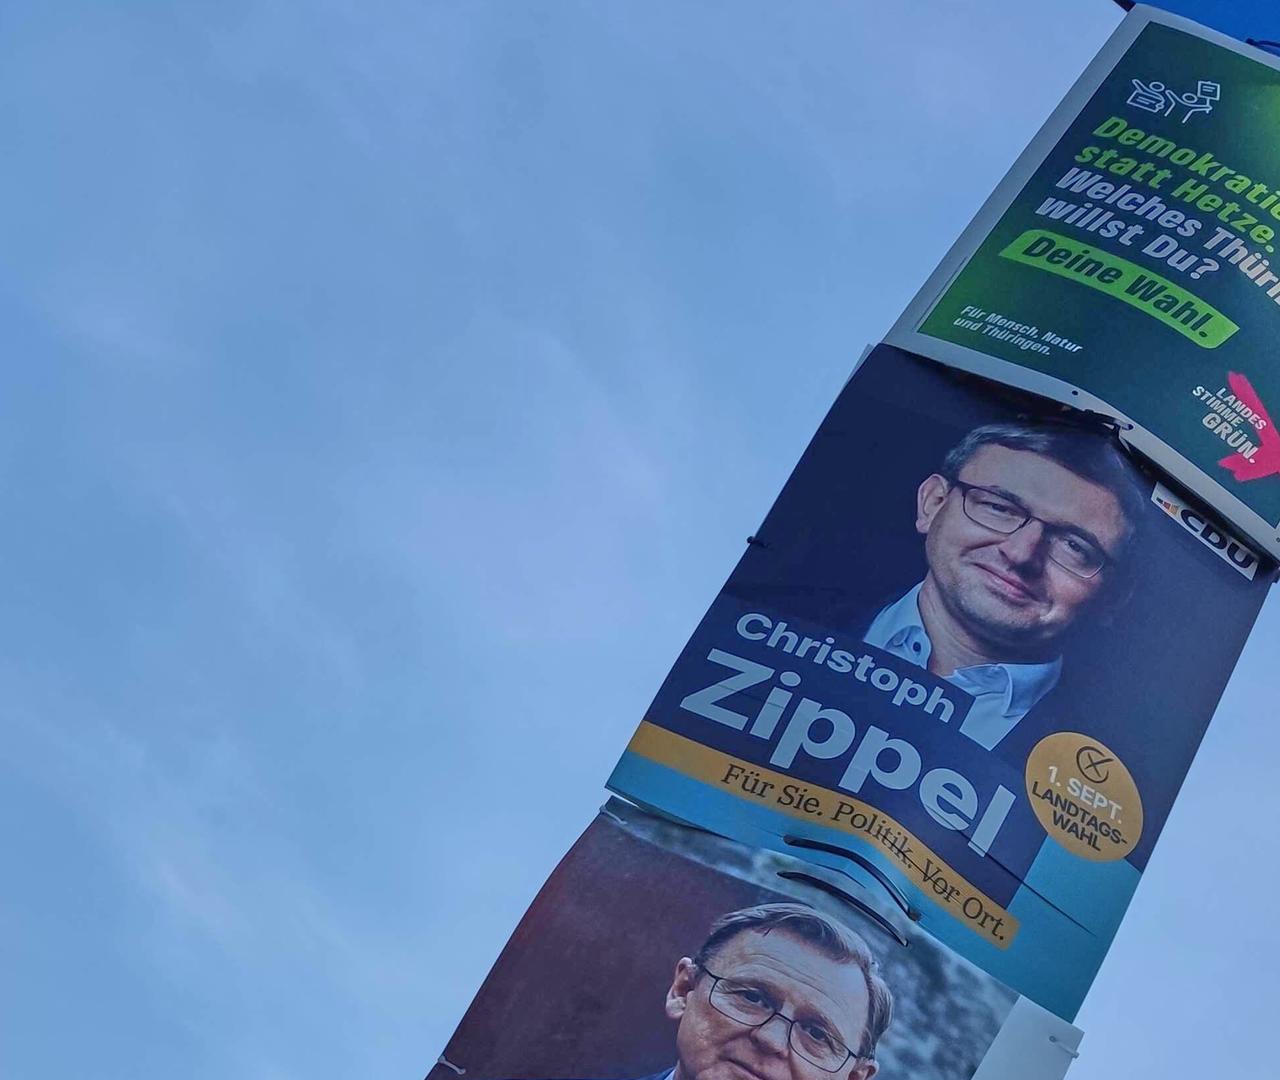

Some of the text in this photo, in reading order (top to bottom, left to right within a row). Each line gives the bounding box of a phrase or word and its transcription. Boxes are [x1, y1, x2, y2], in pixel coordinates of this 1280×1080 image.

[1055, 167, 1203, 237] Welches
[1074, 145, 1275, 253] statt Hetze.
[1034, 197, 1220, 280] willst Du?
[1021, 236, 1214, 338] Deine Wahl.
[953, 316, 1051, 356] und Thüringen.
[960, 305, 1083, 353] Für Mensch, Natur
[1192, 385, 1244, 428] STIMME
[1216, 387, 1267, 430] LANDES
[1202, 412, 1259, 464] GRÜN.
[1180, 509, 1256, 569] CDU
[734, 612, 957, 723] Christoph
[680, 648, 1017, 858] Zippel
[1031, 780, 1128, 845] LANDTAGS-
[1047, 765, 1123, 825] 1. SEPT.
[719, 763, 1006, 941] Für Sie. Politik. Vor Ort.
[1052, 809, 1101, 852] WAHL
